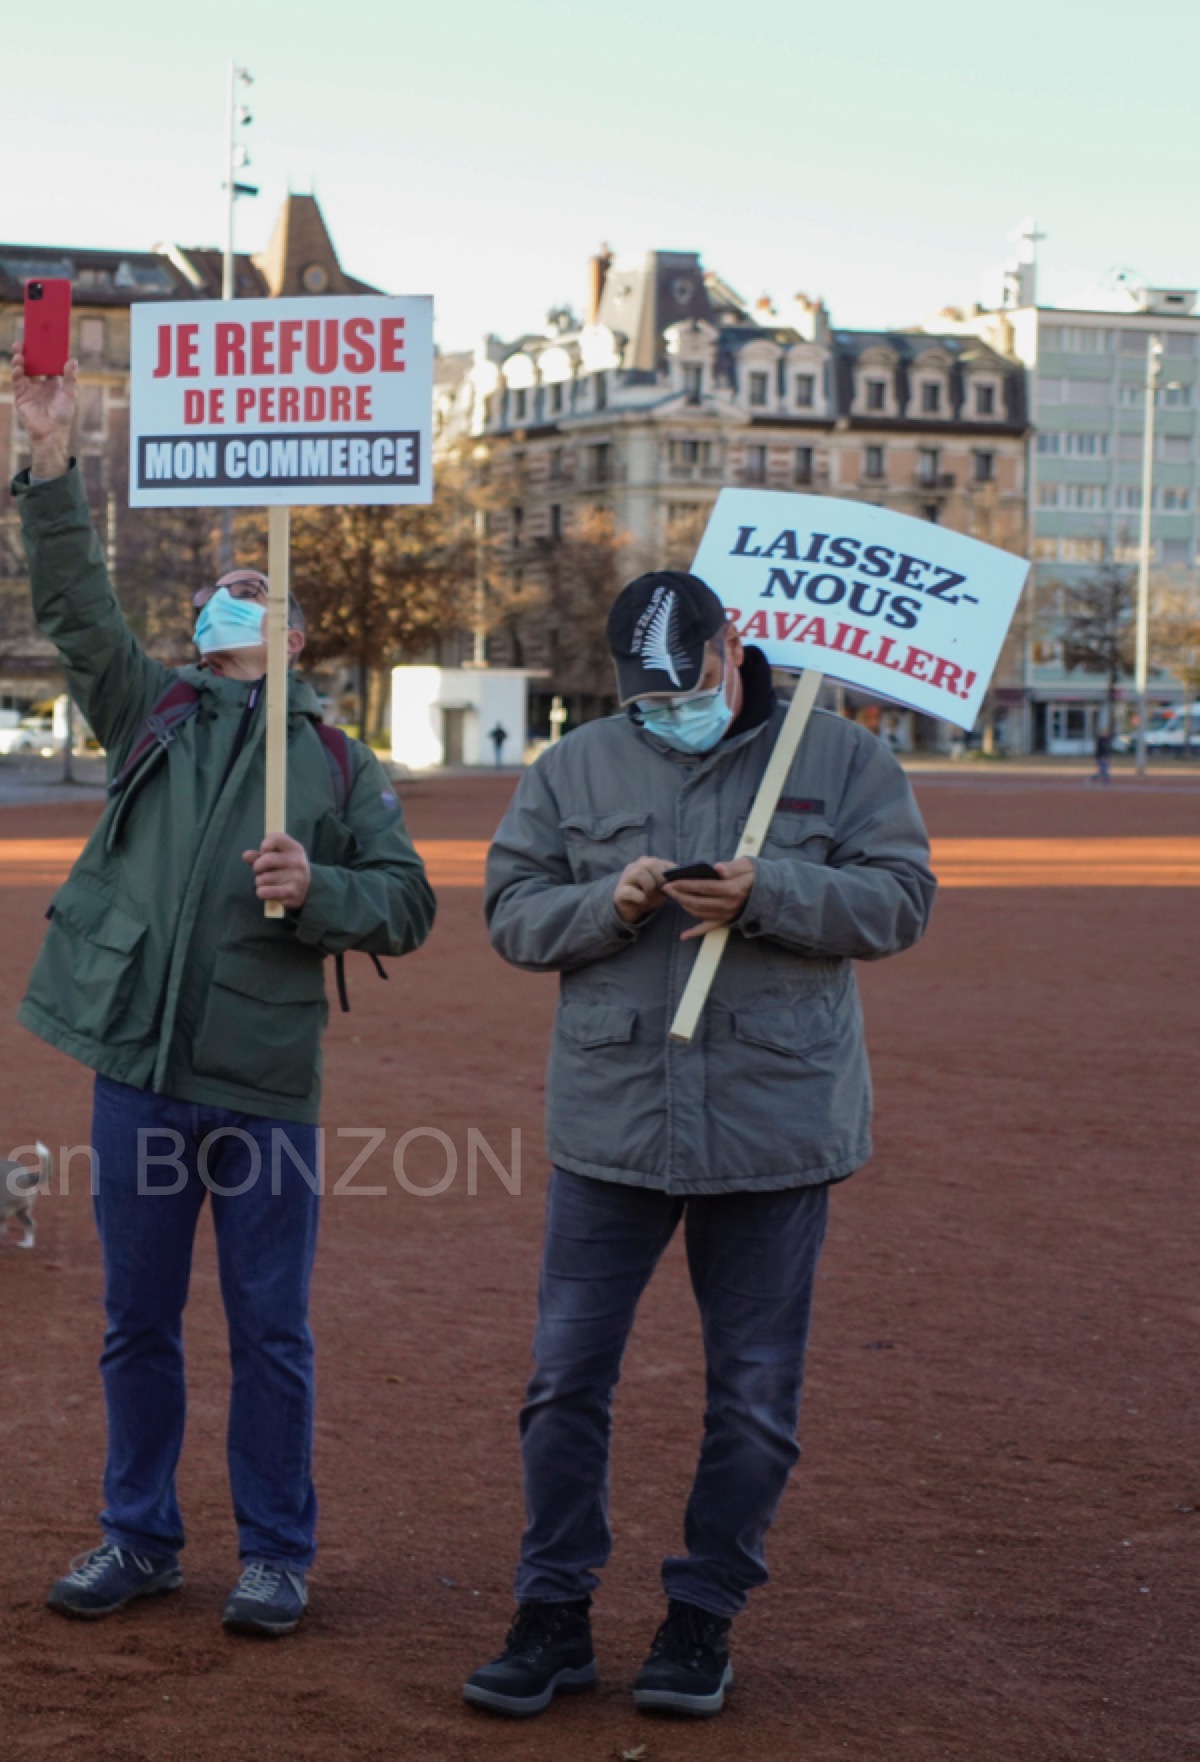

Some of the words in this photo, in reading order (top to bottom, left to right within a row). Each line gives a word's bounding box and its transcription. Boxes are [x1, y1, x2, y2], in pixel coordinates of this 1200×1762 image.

[152, 323, 200, 379] JE
[214, 316, 406, 377] REFUSE
[183, 388, 225, 425] DE
[235, 385, 373, 424] PERDRE
[145, 440, 217, 480] MON
[224, 437, 415, 479] COMMERCE
[729, 525, 979, 605] LAISSEZ-
[759, 567, 923, 629] NOUS
[723, 607, 978, 700] AVAILLER!
